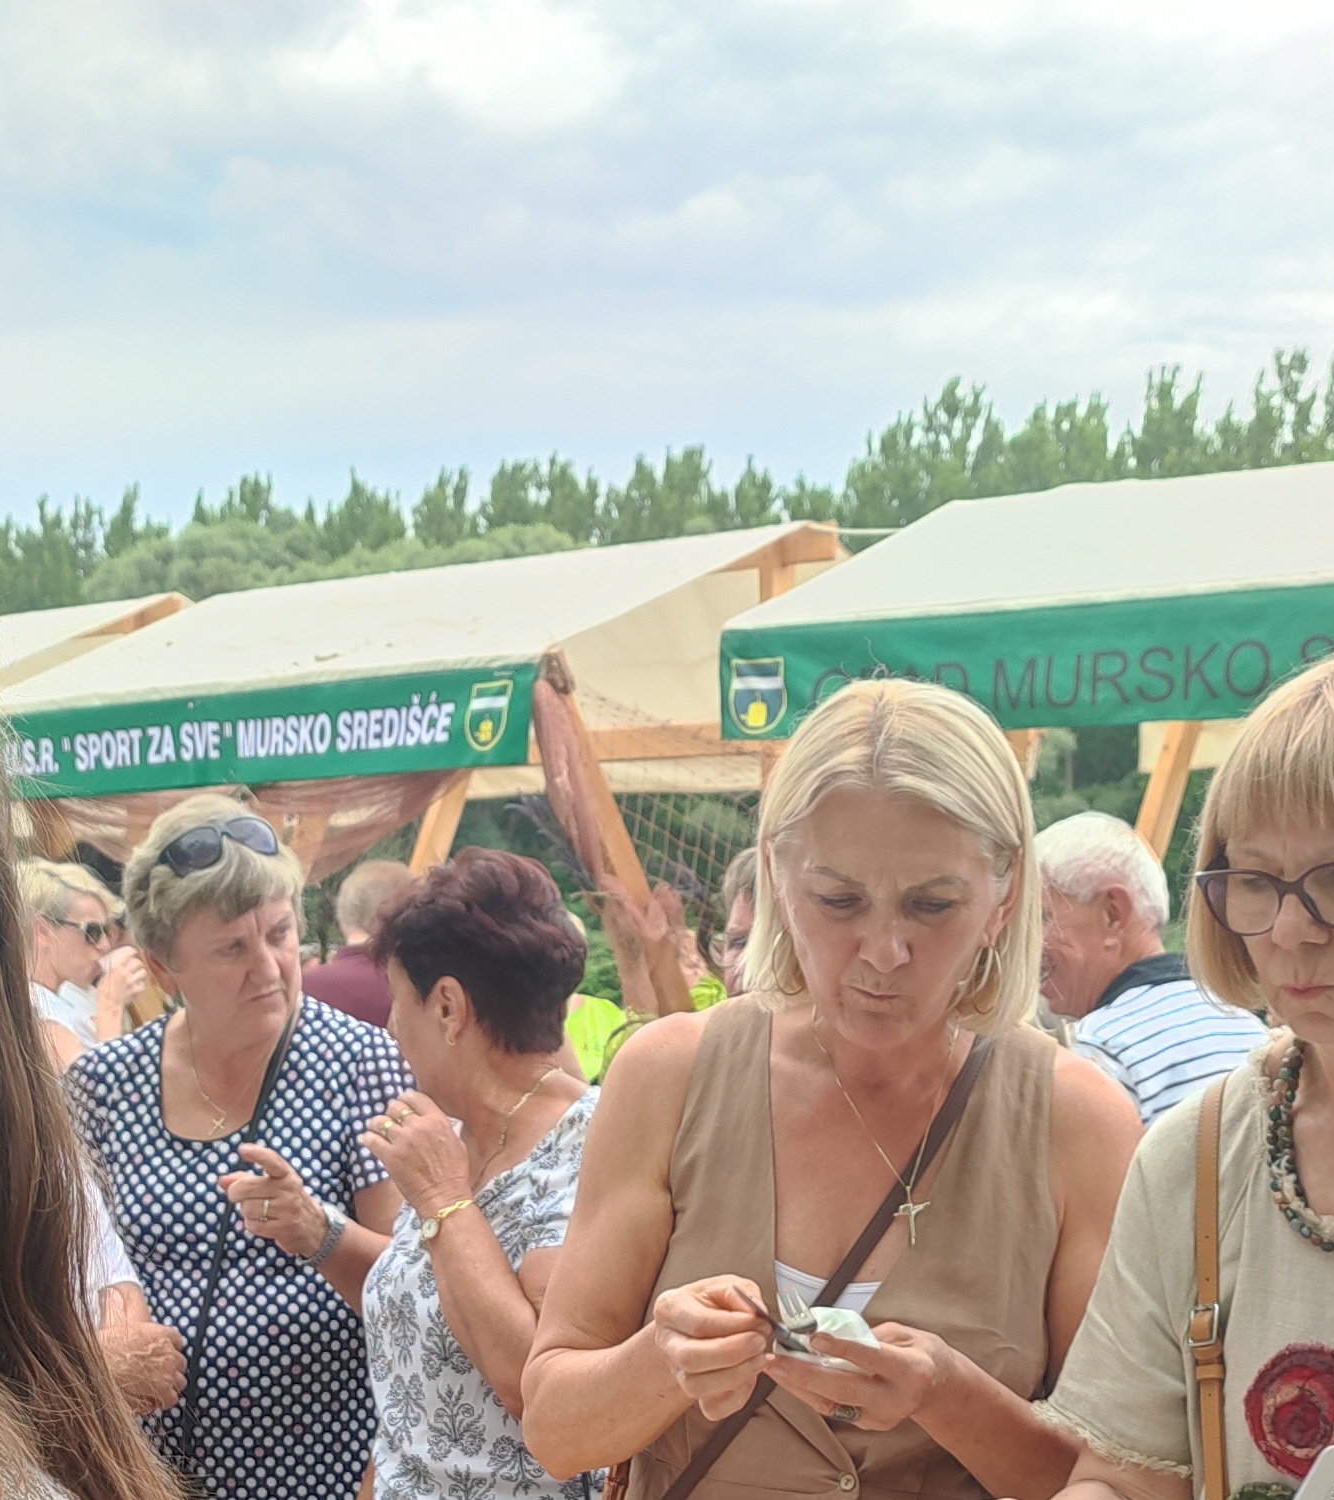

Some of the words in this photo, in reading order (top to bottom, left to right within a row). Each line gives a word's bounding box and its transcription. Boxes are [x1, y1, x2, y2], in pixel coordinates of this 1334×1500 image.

[993, 640, 1270, 710] MURSKO
[146, 725, 176, 765] ZA
[237, 712, 332, 758] MURSKO
[335, 691, 456, 752] SREDIŠĆE
